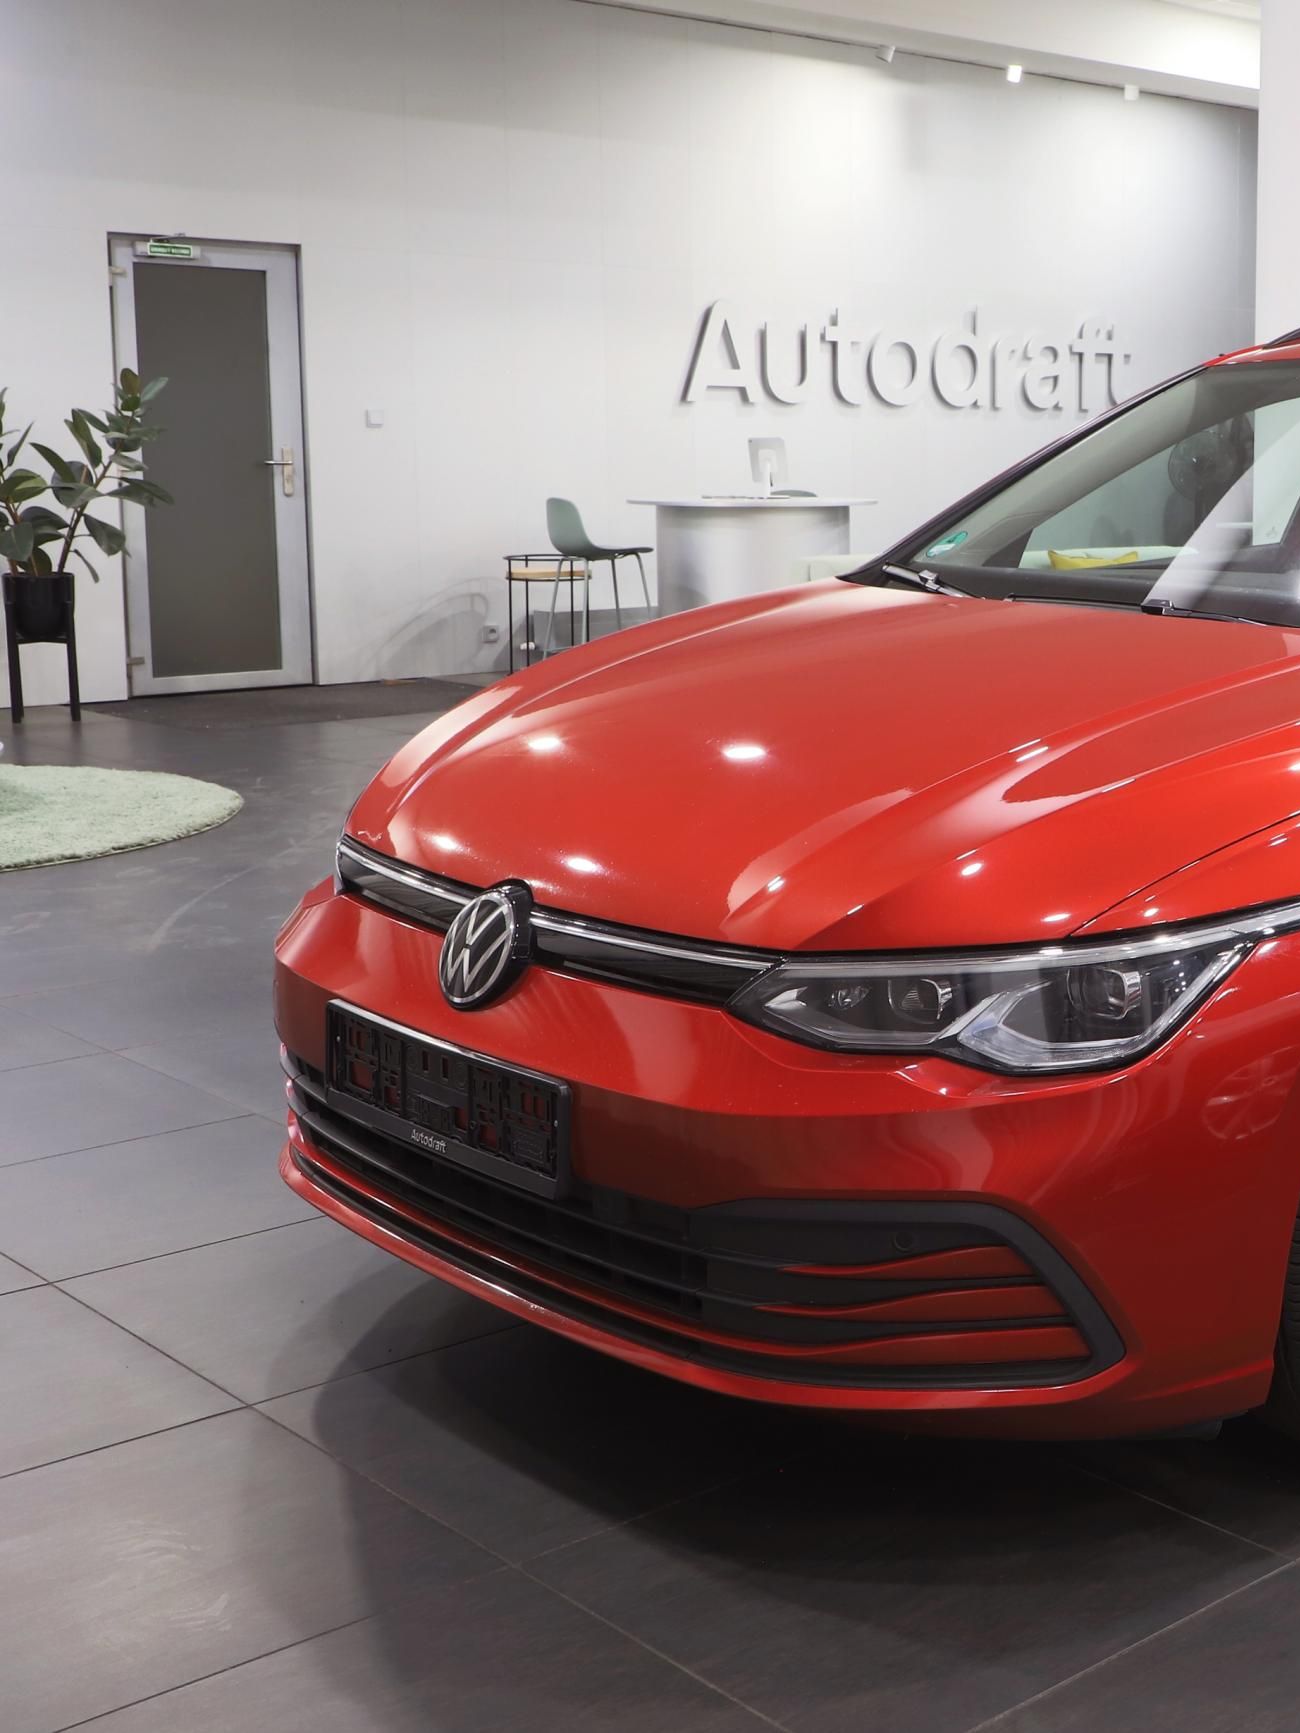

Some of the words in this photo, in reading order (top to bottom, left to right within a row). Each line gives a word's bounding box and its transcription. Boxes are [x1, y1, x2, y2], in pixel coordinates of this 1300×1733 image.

[678, 299, 1131, 411] Autodraft
[439, 890, 515, 1003] VW
[411, 1129, 447, 1154] Autodraft
